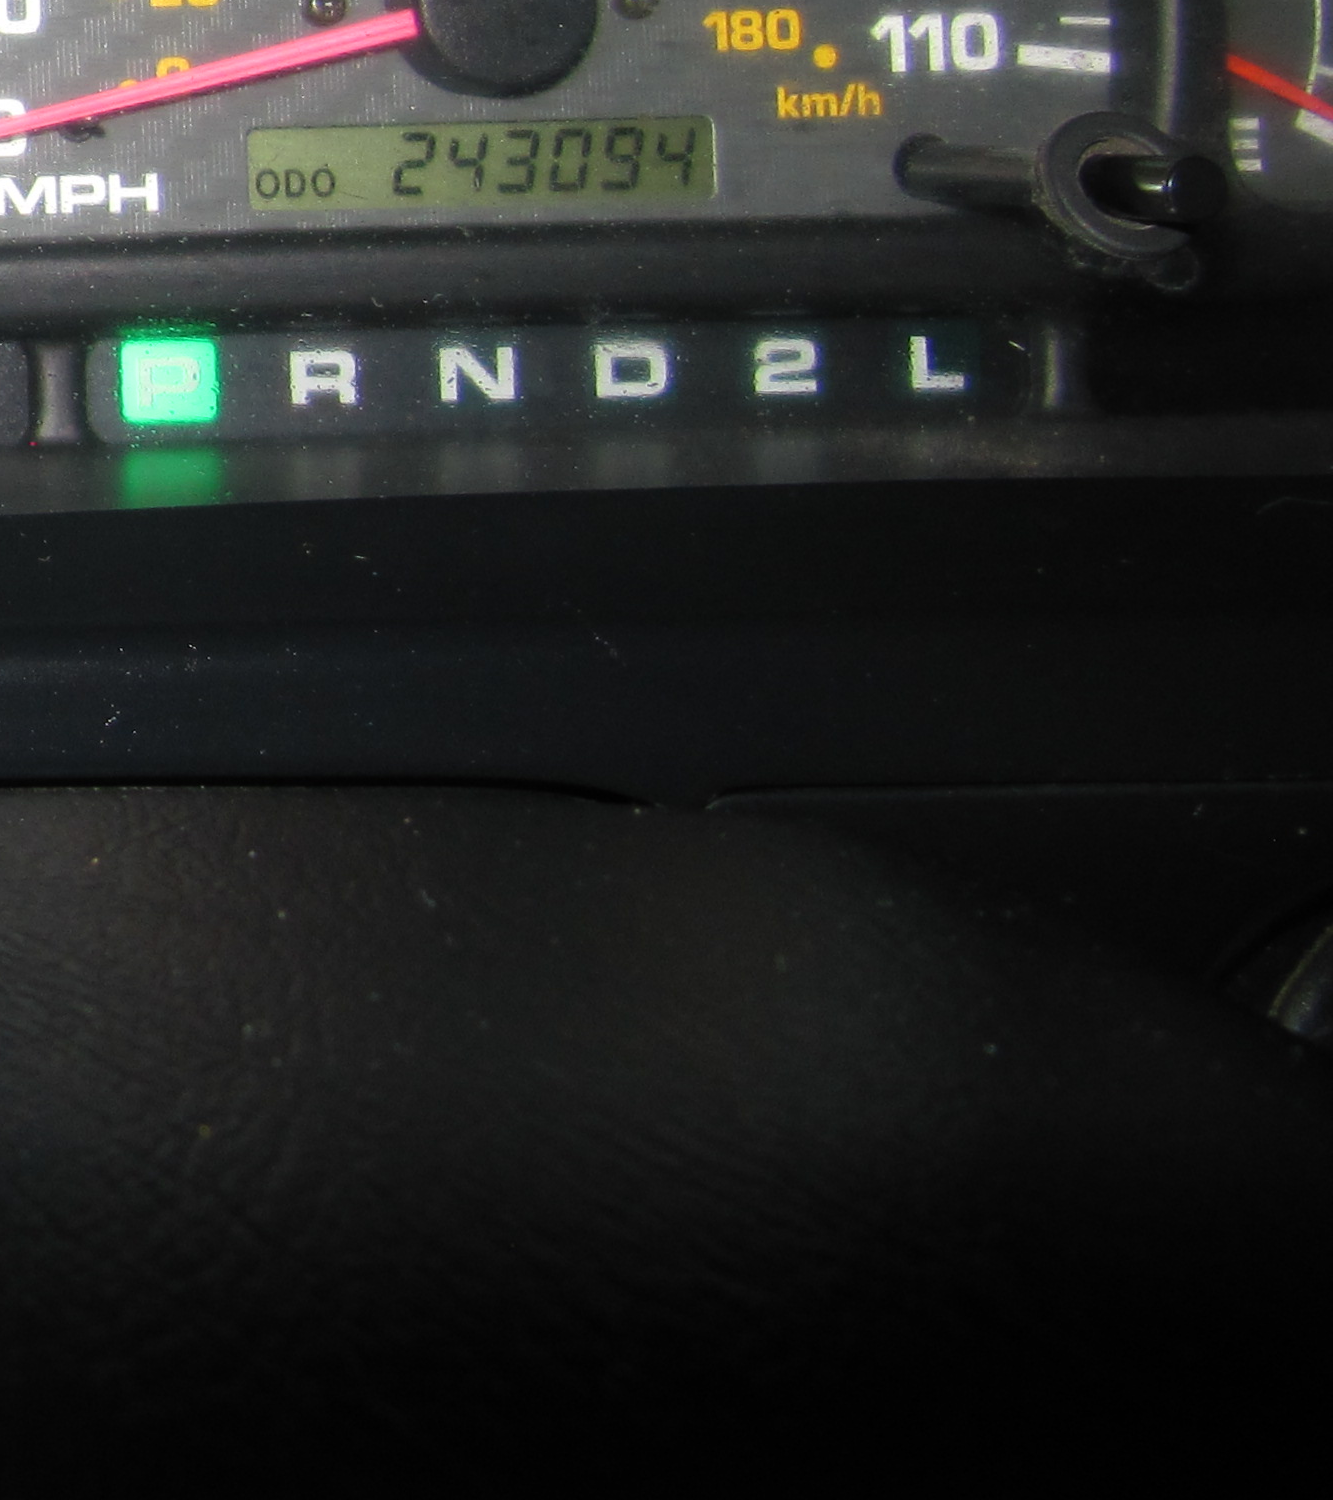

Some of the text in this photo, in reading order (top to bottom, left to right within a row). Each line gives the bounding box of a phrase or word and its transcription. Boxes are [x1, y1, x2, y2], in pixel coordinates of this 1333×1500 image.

[704, 9, 801, 51] 180
[871, 12, 1000, 73] 110
[777, 84, 882, 119] km/h
[256, 126, 696, 199] ODO 243094
[137, 336, 968, 408] P R N D 2 L
